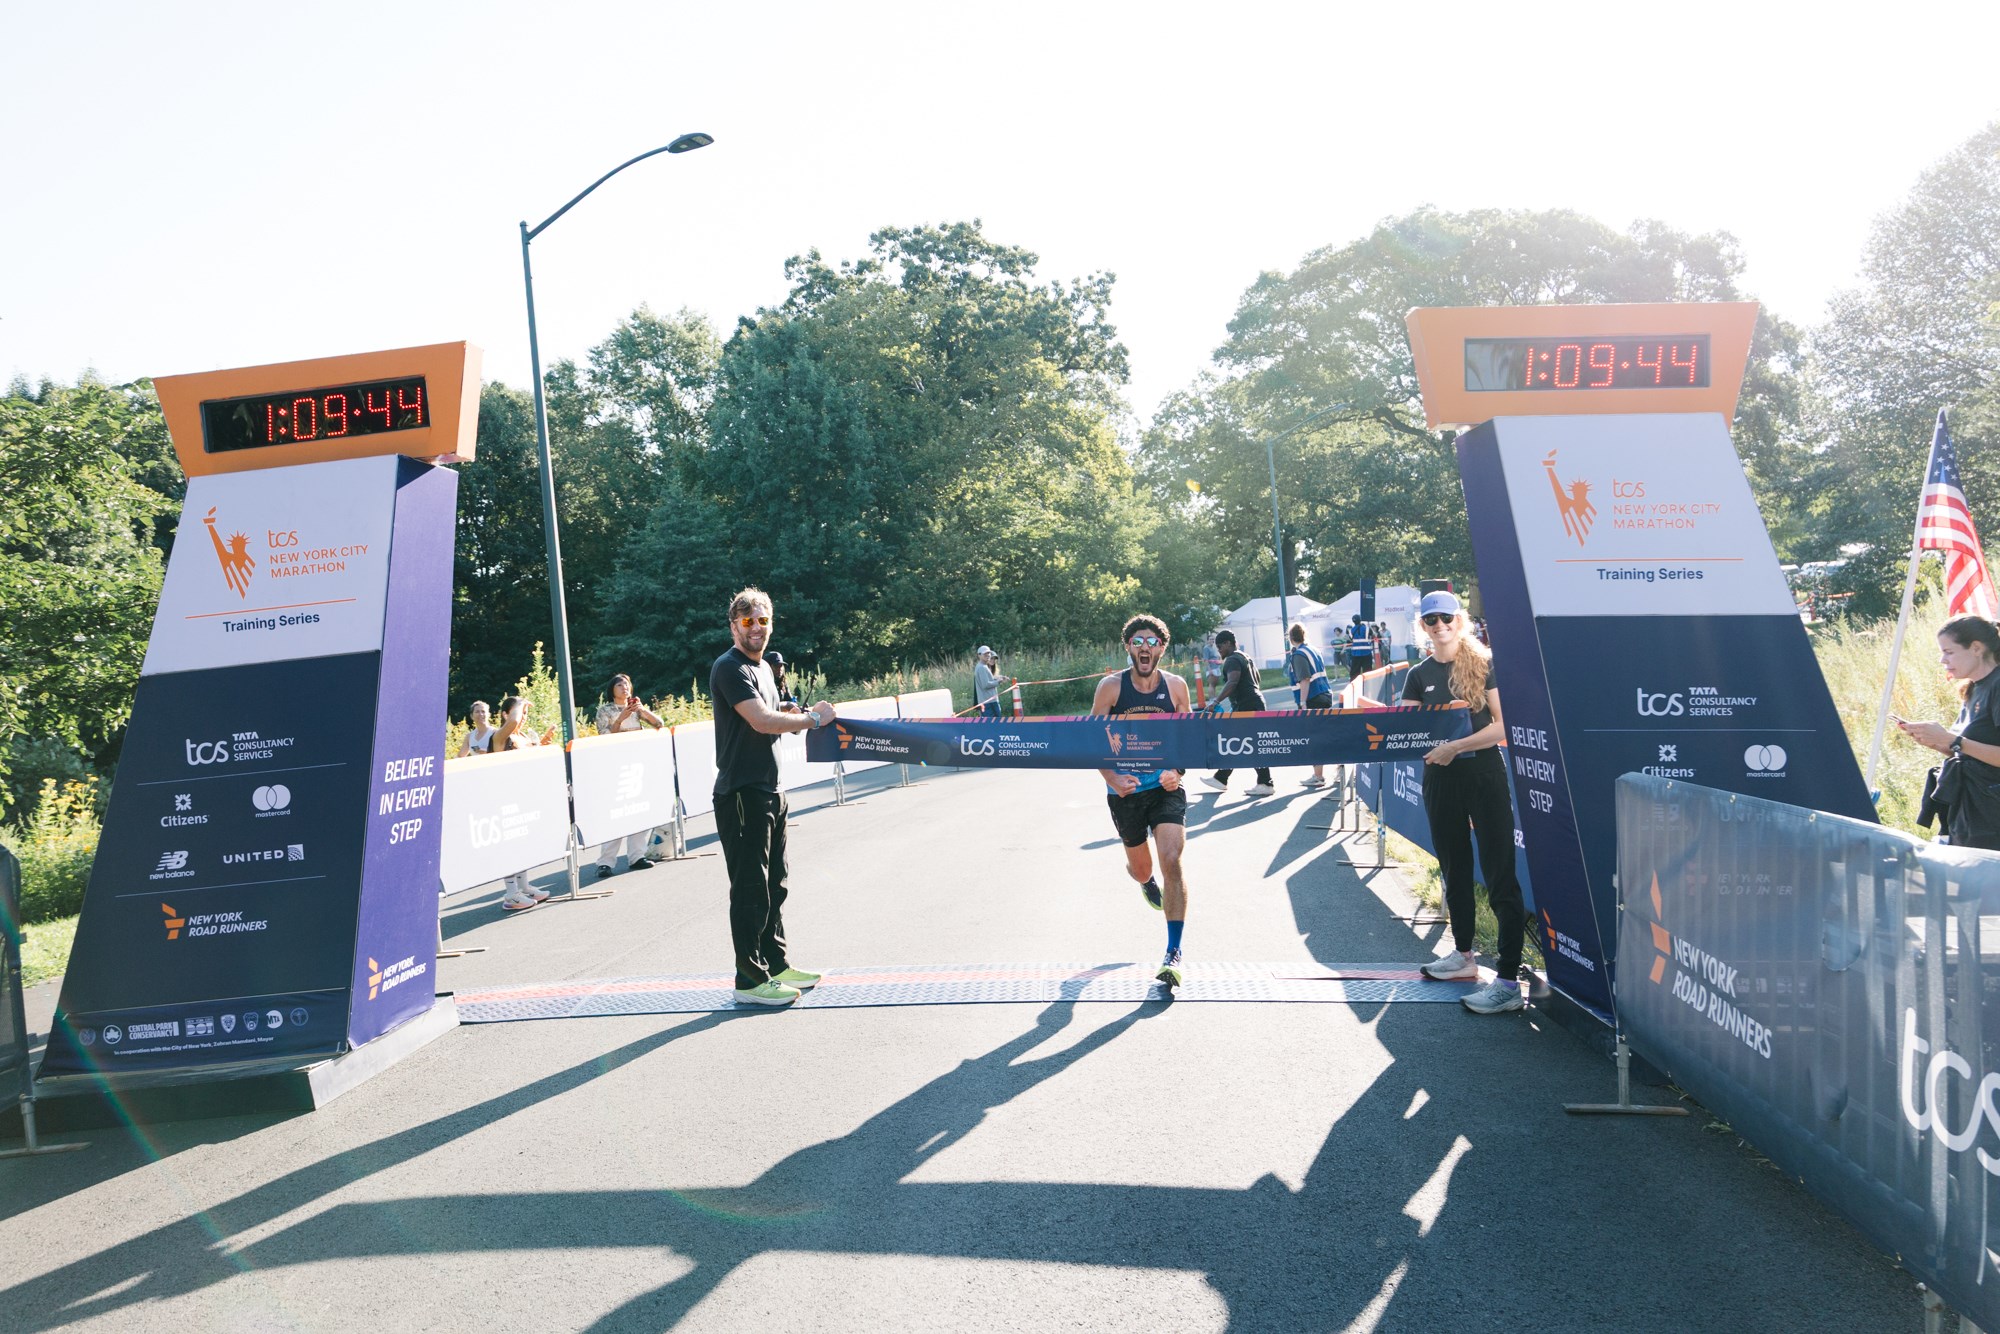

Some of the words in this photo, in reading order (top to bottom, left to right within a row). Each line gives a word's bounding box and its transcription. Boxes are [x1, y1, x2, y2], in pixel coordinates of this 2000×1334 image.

[1613, 478, 1645, 498] tcs
[1613, 504, 1646, 515] NEW
[1650, 504, 1687, 514] YORK
[1691, 504, 1721, 514] CITY
[1614, 519, 1695, 529] MARATHON
[267, 529, 299, 548] tcs
[269, 552, 299, 564] NEW
[303, 548, 337, 561] YORK
[340, 545, 368, 557] CITY
[271, 561, 345, 578] MARATHON
[1597, 568, 1654, 582] Training
[1658, 568, 1703, 580] Series
[223, 618, 276, 632] Training
[279, 613, 320, 626] Series
[1689, 687, 1718, 695] TATA
[1637, 687, 1684, 716] tcs
[1689, 697, 1757, 706] CONSULTANCY
[1690, 708, 1733, 716] SERVICES
[232, 731, 259, 741] TATA
[855, 736, 871, 744] NEW
[871, 737, 892, 746] YORK
[1257, 738, 1310, 747] CONSULTANCY
[1386, 733, 1407, 741] NEW
[1408, 731, 1430, 740] YORK
[1512, 726, 1549, 752] BELIEVE
[186, 738, 229, 766] tcs
[233, 738, 295, 751] CONSULTANCY
[855, 742, 874, 750] ROAD
[876, 744, 909, 754] RUNNERS
[960, 734, 995, 756] tcs
[1218, 733, 1254, 756] tcs
[1257, 746, 1291, 755] SERVICES
[1386, 740, 1410, 749] ROAD
[234, 750, 273, 762] SERVICES
[384, 756, 435, 783] BELIEVE
[1515, 756, 1525, 776] IN
[1526, 757, 1556, 784] EVERY
[1642, 766, 1694, 777] Citizens
[379, 793, 393, 816] IN
[396, 785, 436, 812] EVERY
[1529, 789, 1553, 814] STEP
[160, 814, 209, 827] Citizens
[255, 809, 291, 818] mastercard
[390, 818, 422, 845] STEP
[469, 813, 501, 849] tcs
[223, 850, 284, 864] UNITED
[165, 870, 195, 879] balance
[188, 915, 212, 926] NEW
[214, 911, 243, 923] YORK
[188, 926, 217, 937] ROAD
[219, 920, 268, 934] RUNNERS
[1556, 931, 1567, 944] NEW
[1567, 936, 1581, 952] YORK
[1559, 943, 1572, 958] ROAD
[1572, 950, 1594, 972] RUNNERS
[383, 962, 399, 980] NEW
[398, 955, 415, 972] YORK
[1674, 936, 1700, 973] NEW
[1700, 950, 1738, 998] YORK
[382, 974, 400, 993] ROAD
[400, 962, 427, 984] RUNNERS
[1672, 970, 1707, 1012] ROAD
[1707, 992, 1772, 1059] RUNNERS
[128, 1023, 155, 1033] CENTRAL
[155, 1022, 173, 1030] PARK
[129, 1030, 173, 1040] CONSERVANCY
